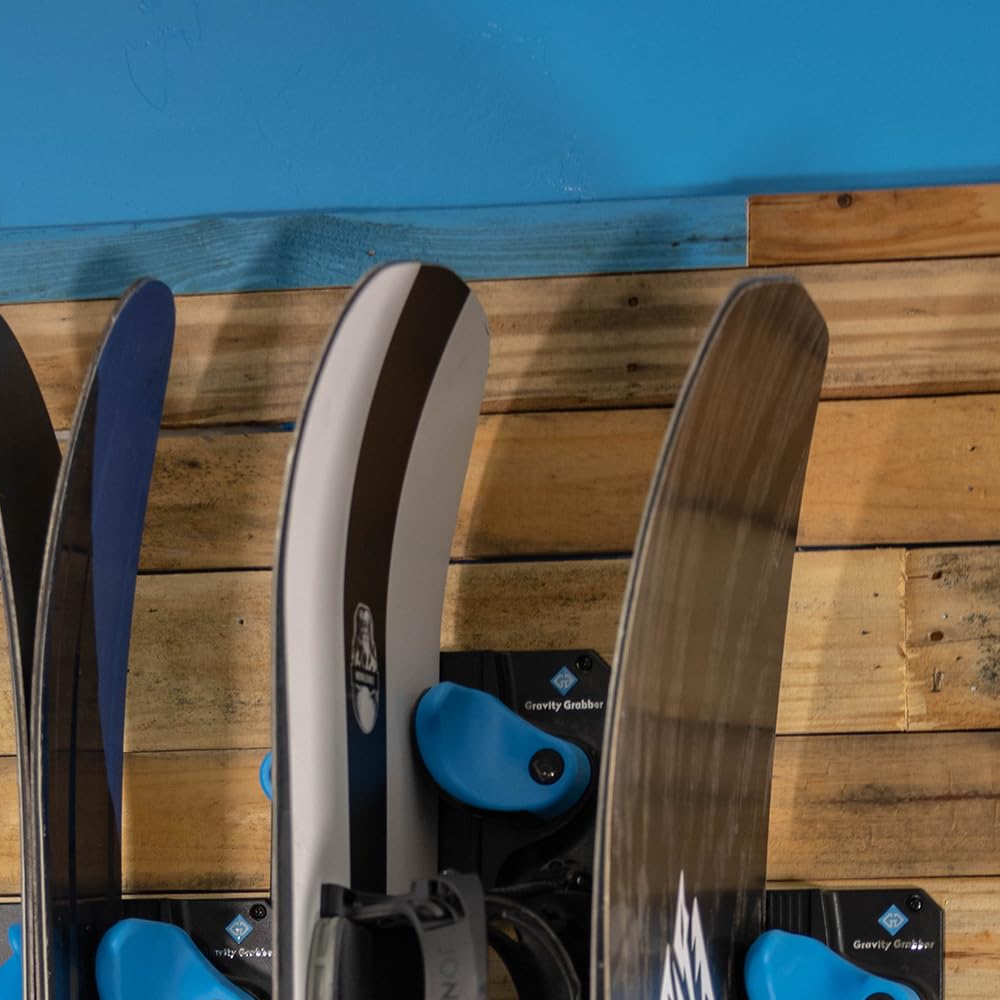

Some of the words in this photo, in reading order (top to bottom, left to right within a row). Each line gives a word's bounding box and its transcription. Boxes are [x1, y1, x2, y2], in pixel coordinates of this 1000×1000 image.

[524, 700, 562, 712] Gravity
[563, 699, 604, 710] Grabber
[853, 939, 892, 951] Gravity
